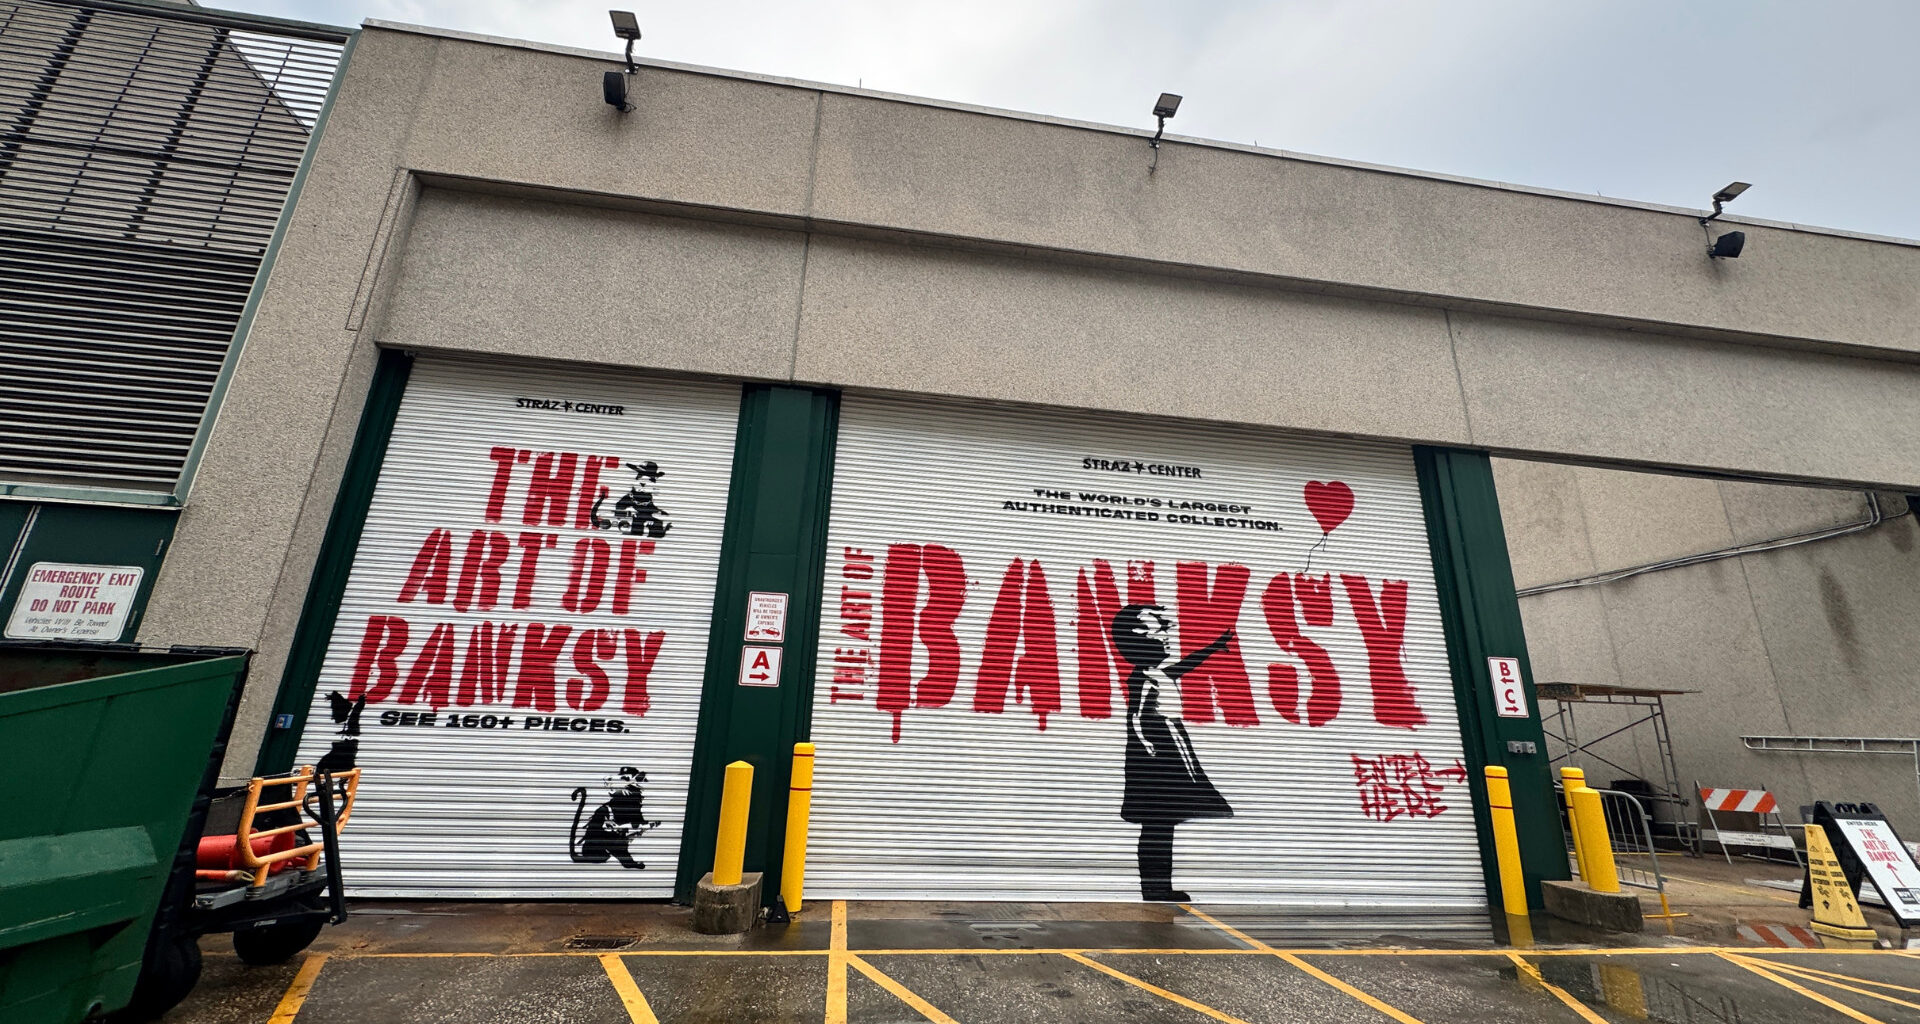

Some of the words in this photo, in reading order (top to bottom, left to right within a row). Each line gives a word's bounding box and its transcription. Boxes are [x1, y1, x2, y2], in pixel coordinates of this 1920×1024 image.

[516, 397, 560, 411] STRAZ
[575, 402, 624, 416] CENTER
[1083, 457, 1131, 473] STRAZ
[1147, 463, 1202, 479] CENTER
[485, 446, 620, 530] THE
[1033, 488, 1071, 500] THE
[1079, 491, 1162, 508] WORLD'S
[1168, 500, 1252, 515] LARGEST
[1002, 500, 1160, 522] AUTHENTICATED
[1166, 513, 1284, 532] COLLECTION.
[397, 528, 558, 613] ART
[562, 537, 656, 615] OF
[842, 546, 875, 580] OF
[31, 569, 105, 585] EMERGENCY
[108, 573, 138, 587] EXIT
[59, 585, 100, 600] ROUTE
[30, 598, 49, 612] DO
[51, 600, 80, 614] NOT
[82, 601, 117, 615] PARK
[839, 585, 872, 640] ART
[875, 543, 1428, 738] BANKSY
[348, 615, 667, 716] BANKSY
[752, 651, 770, 670] A
[1499, 661, 1511, 677] B
[830, 648, 869, 704] THE
[1504, 689, 1516, 704] C
[380, 710, 437, 727] SEE
[445, 713, 515, 730] 160+
[524, 716, 631, 734] PIECES.
[1350, 751, 1434, 787] ENTER
[1360, 783, 1449, 823] HERE
[1858, 828, 1879, 840] THE
[1862, 840, 1880, 851] ART
[1878, 840, 1890, 851] OF
[1865, 850, 1902, 863] BANKSY
